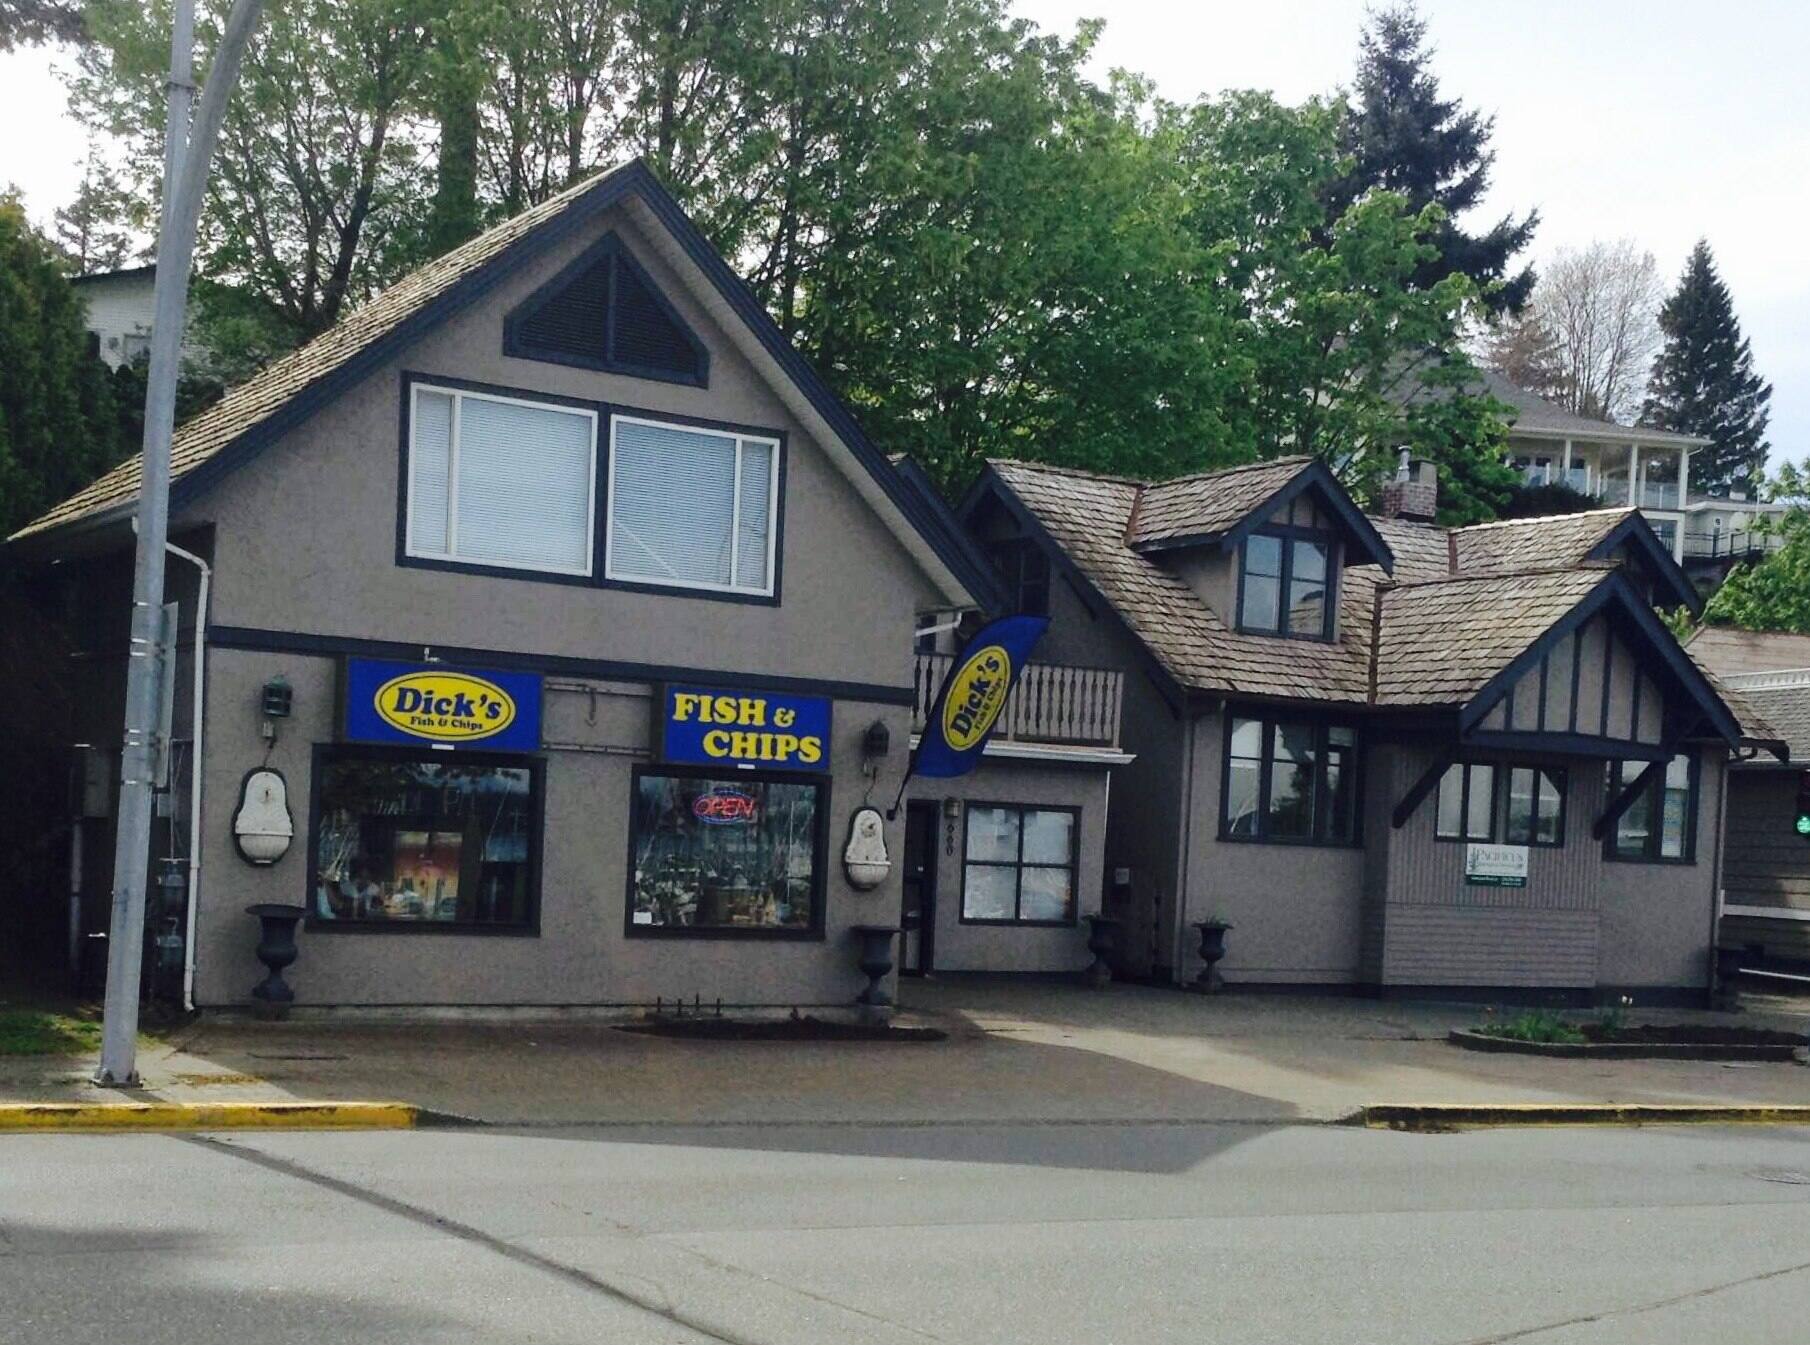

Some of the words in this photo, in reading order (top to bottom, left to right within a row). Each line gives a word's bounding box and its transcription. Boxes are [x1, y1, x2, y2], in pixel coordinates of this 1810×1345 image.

[393, 687, 502, 720] Dick's
[672, 692, 767, 727] FISH
[773, 707, 796, 728] &
[951, 656, 1000, 738] Dick's
[410, 716, 435, 727] Fish
[437, 717, 448, 727] &
[451, 719, 483, 731] Chips
[702, 729, 822, 763] CHIPS
[697, 796, 754, 818] OPEN
